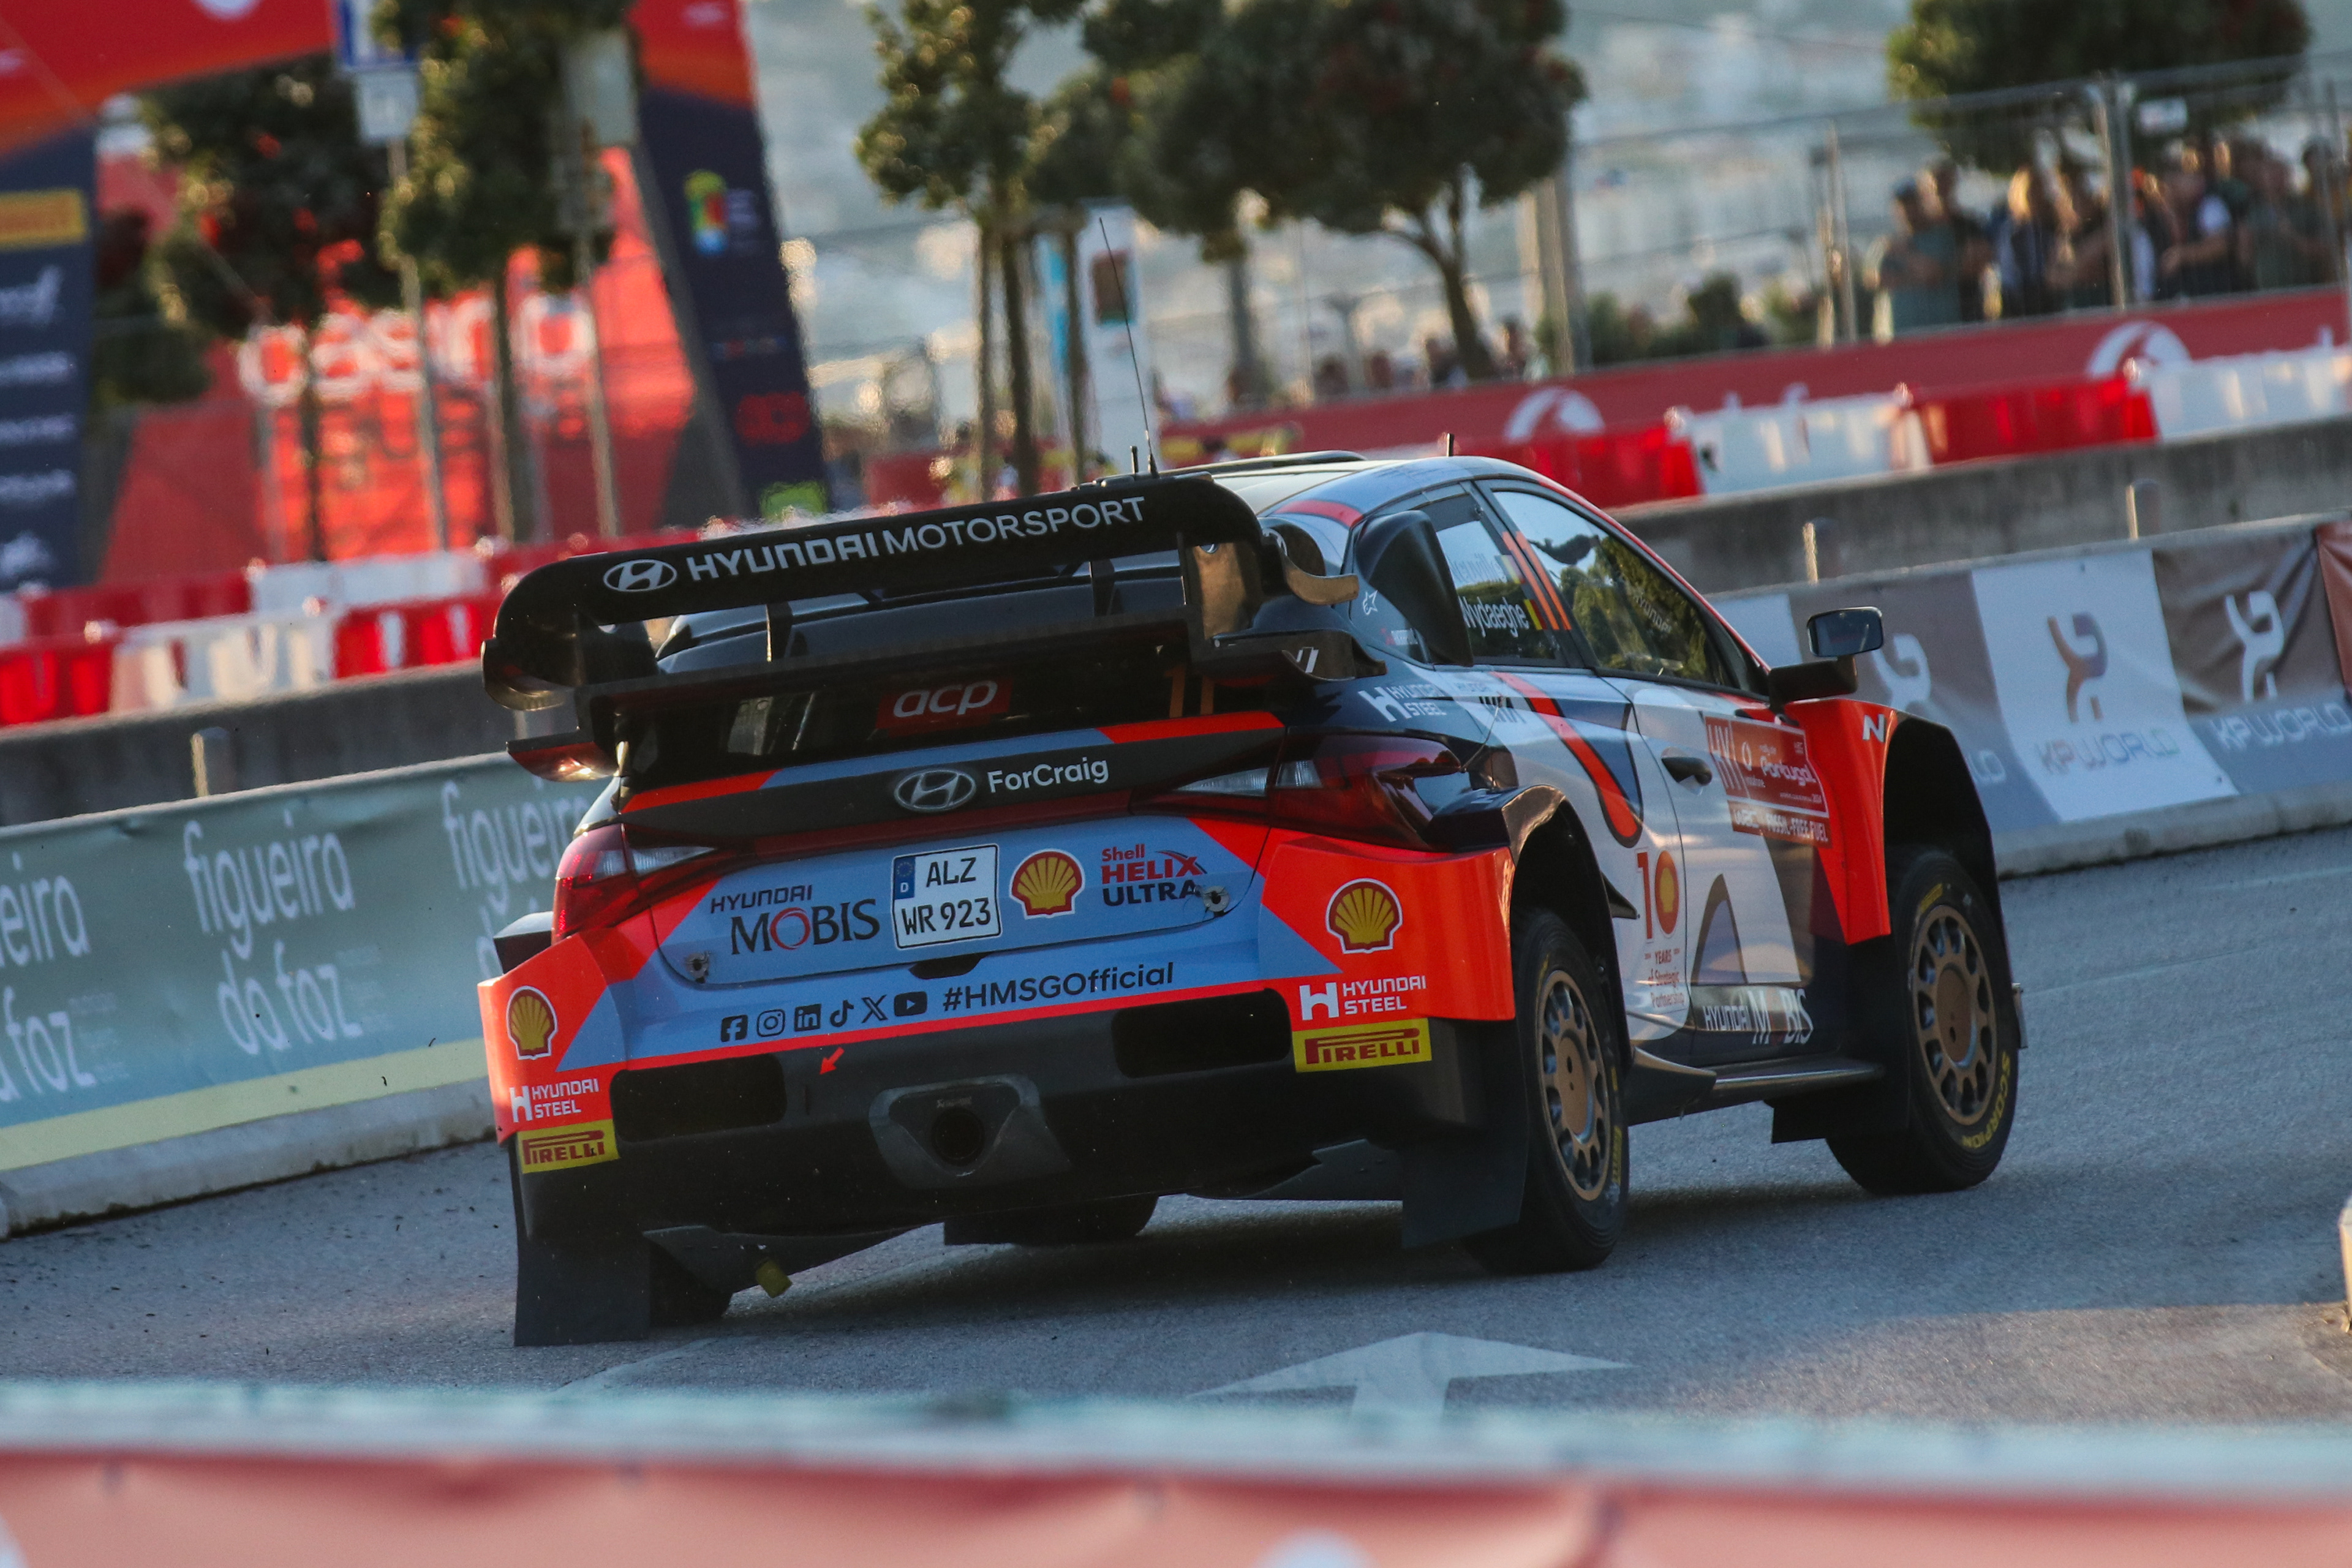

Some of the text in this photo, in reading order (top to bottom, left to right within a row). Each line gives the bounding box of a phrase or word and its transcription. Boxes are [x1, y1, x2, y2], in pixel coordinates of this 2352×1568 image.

[687, 497, 1145, 581] HYUNDAI MOTORSPORT
[893, 680, 998, 718] acp
[1404, 702, 1447, 716] STEEL
[987, 756, 1109, 793] ForCraig
[441, 779, 589, 916] figueir
[1102, 843, 1145, 862] Shell
[926, 857, 976, 888] ALZ
[1101, 853, 1204, 884] HELIX
[710, 884, 813, 913] HYUNDAI
[900, 882, 909, 893] D
[1103, 880, 1201, 907] ULTRA
[731, 899, 880, 955] MOBIS
[902, 897, 991, 935] WR 923
[943, 962, 1174, 1012] #HMSGOfficial
[1343, 975, 1427, 997] HYUNDAI
[1344, 996, 1407, 1015] STEEL
[1702, 988, 1814, 1044] HYUNDAI MOBIS
[1305, 1028, 1420, 1065] PIRELLI
[532, 1079, 599, 1099] HYUNDAI
[1962, 1051, 2011, 1148] SCORPION
[535, 1099, 581, 1118] STEEL
[522, 1130, 605, 1164] PIRELLI
